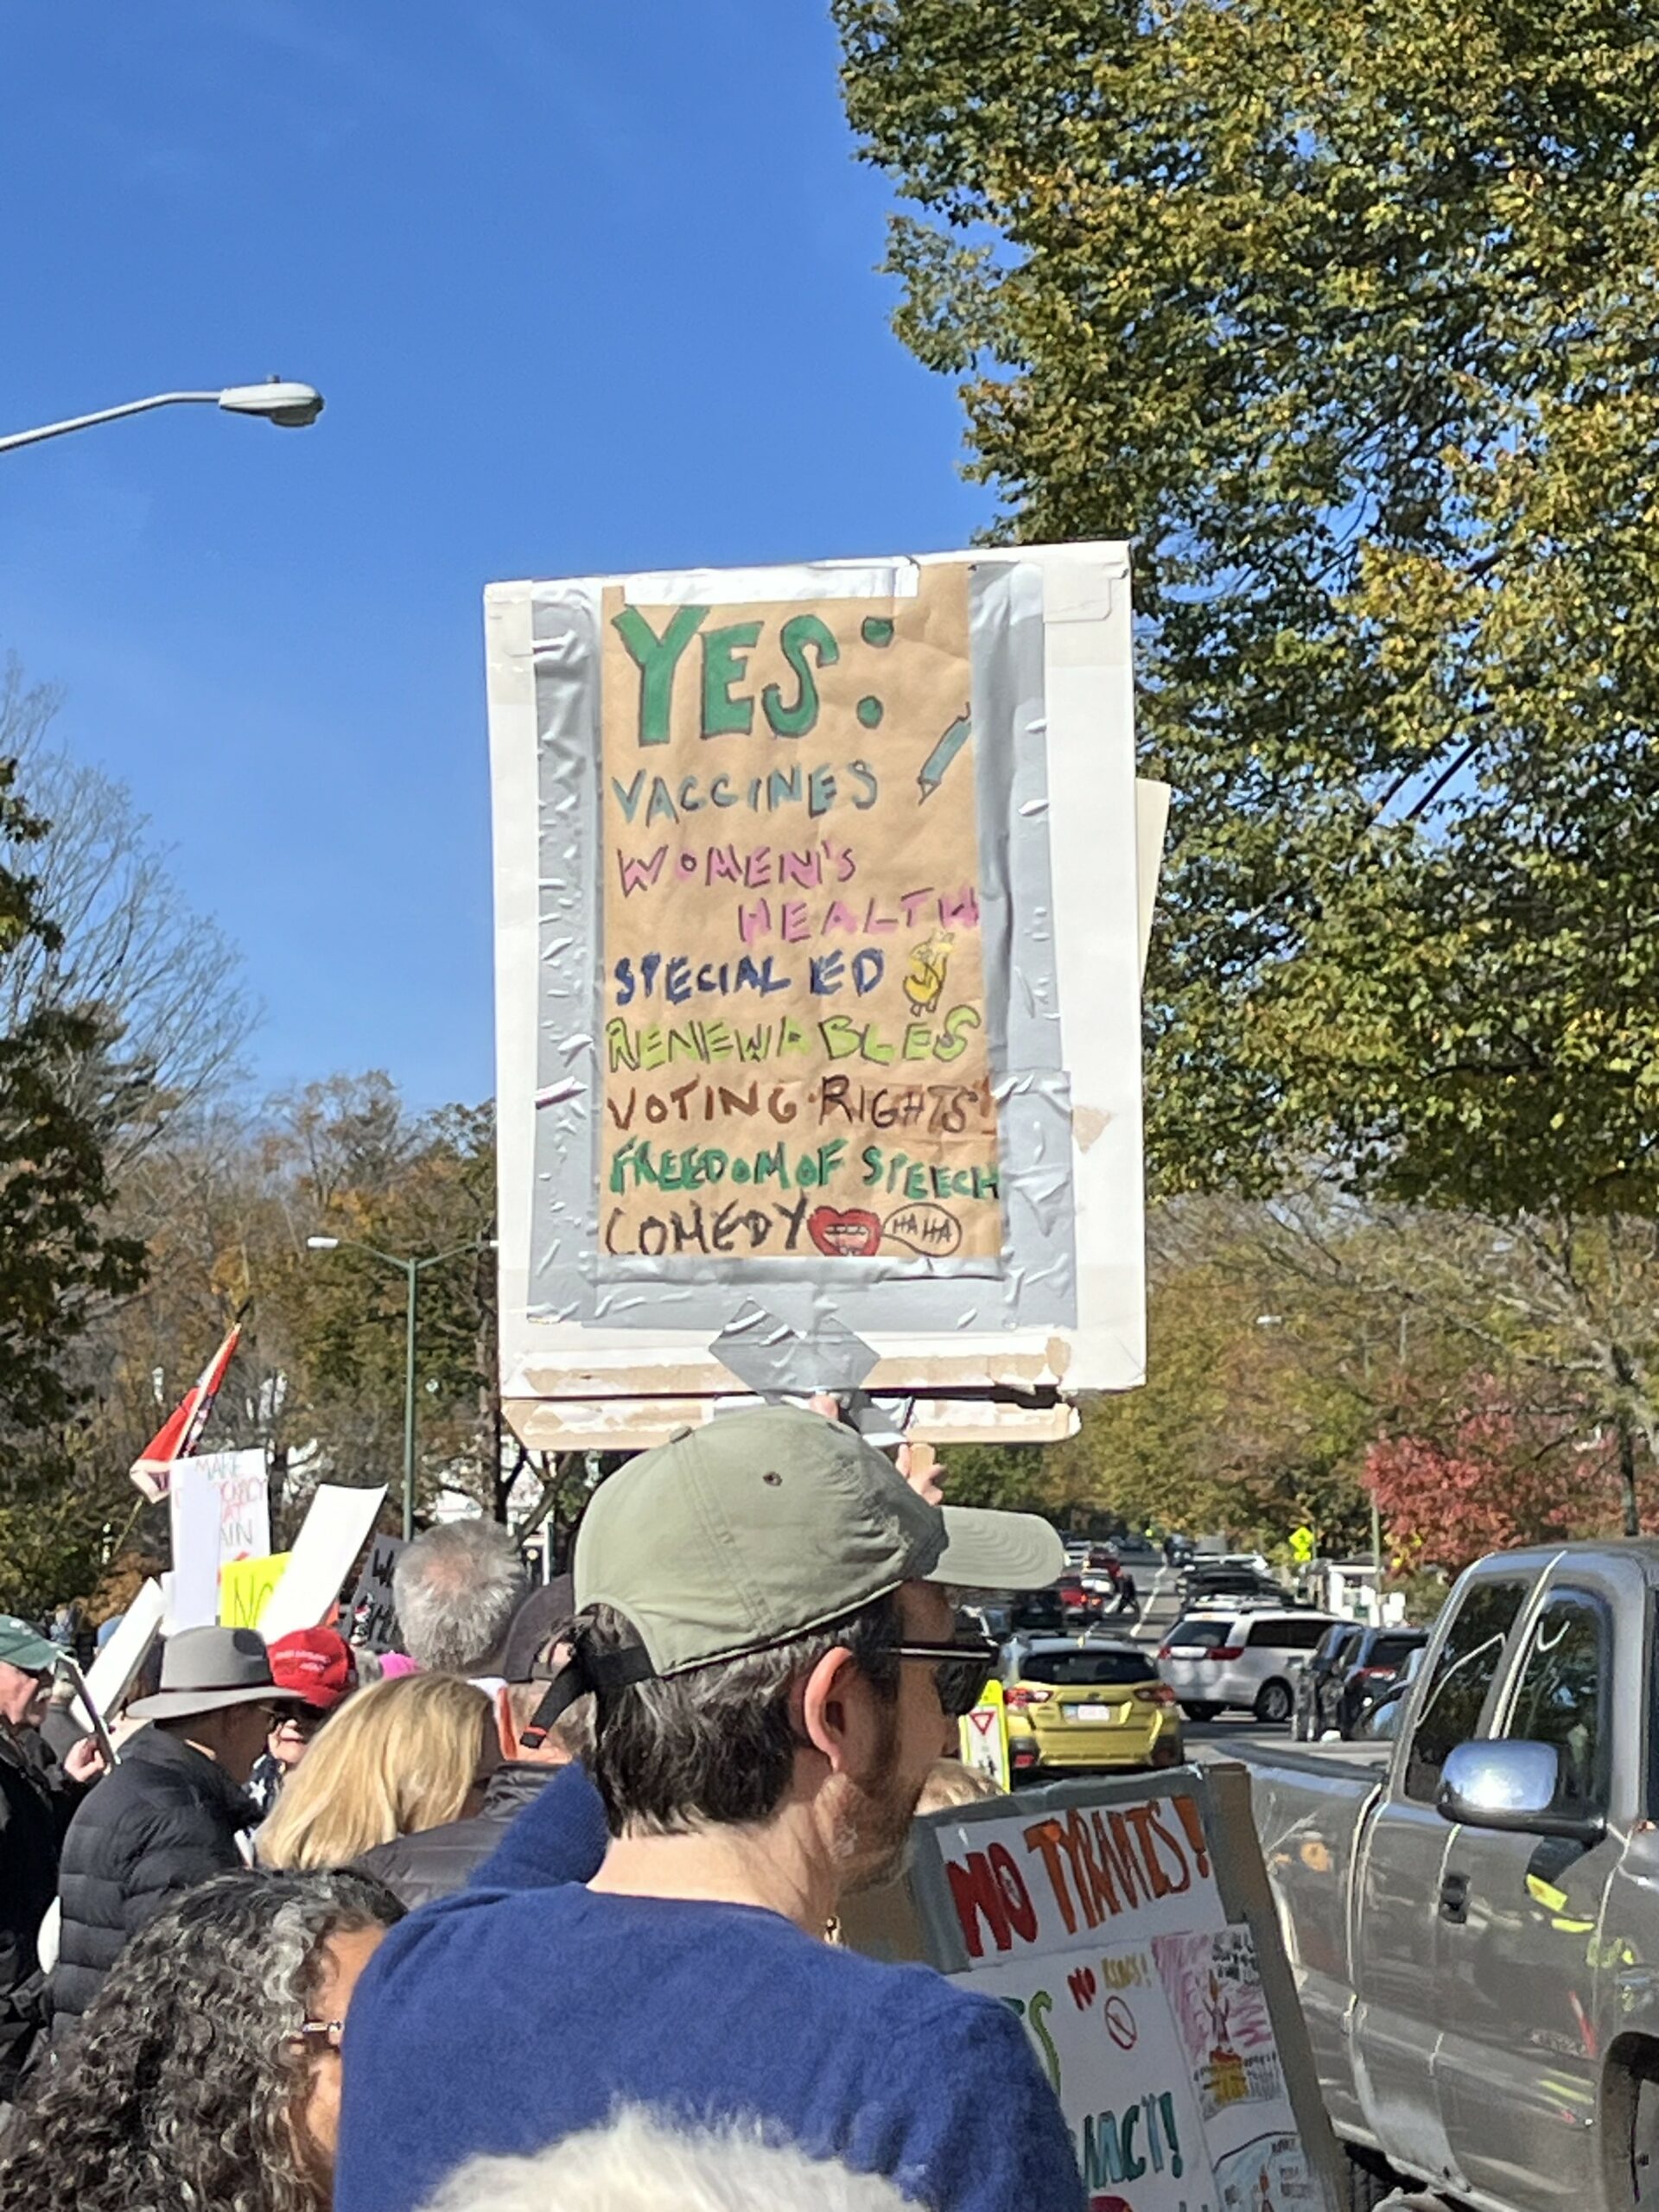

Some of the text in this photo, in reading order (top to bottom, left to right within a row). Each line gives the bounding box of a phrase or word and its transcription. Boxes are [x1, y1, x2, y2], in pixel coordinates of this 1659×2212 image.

[611, 605, 894, 747] YES:
[612, 760, 878, 827] VACCINES
[617, 842, 857, 898] WOMEN'S
[738, 885, 980, 945] HEALTH
[614, 948, 884, 1006] SPECIAL ED
[606, 1004, 982, 1071] RENEWABLES
[607, 1074, 798, 1131] VOTING
[609, 1135, 1001, 1199] FREEDOM OF SPEECH
[606, 1189, 810, 1257] COMEDY
[893, 1212, 952, 1244] HA HA
[946, 1795, 1209, 1957] NO TYRANTS!
